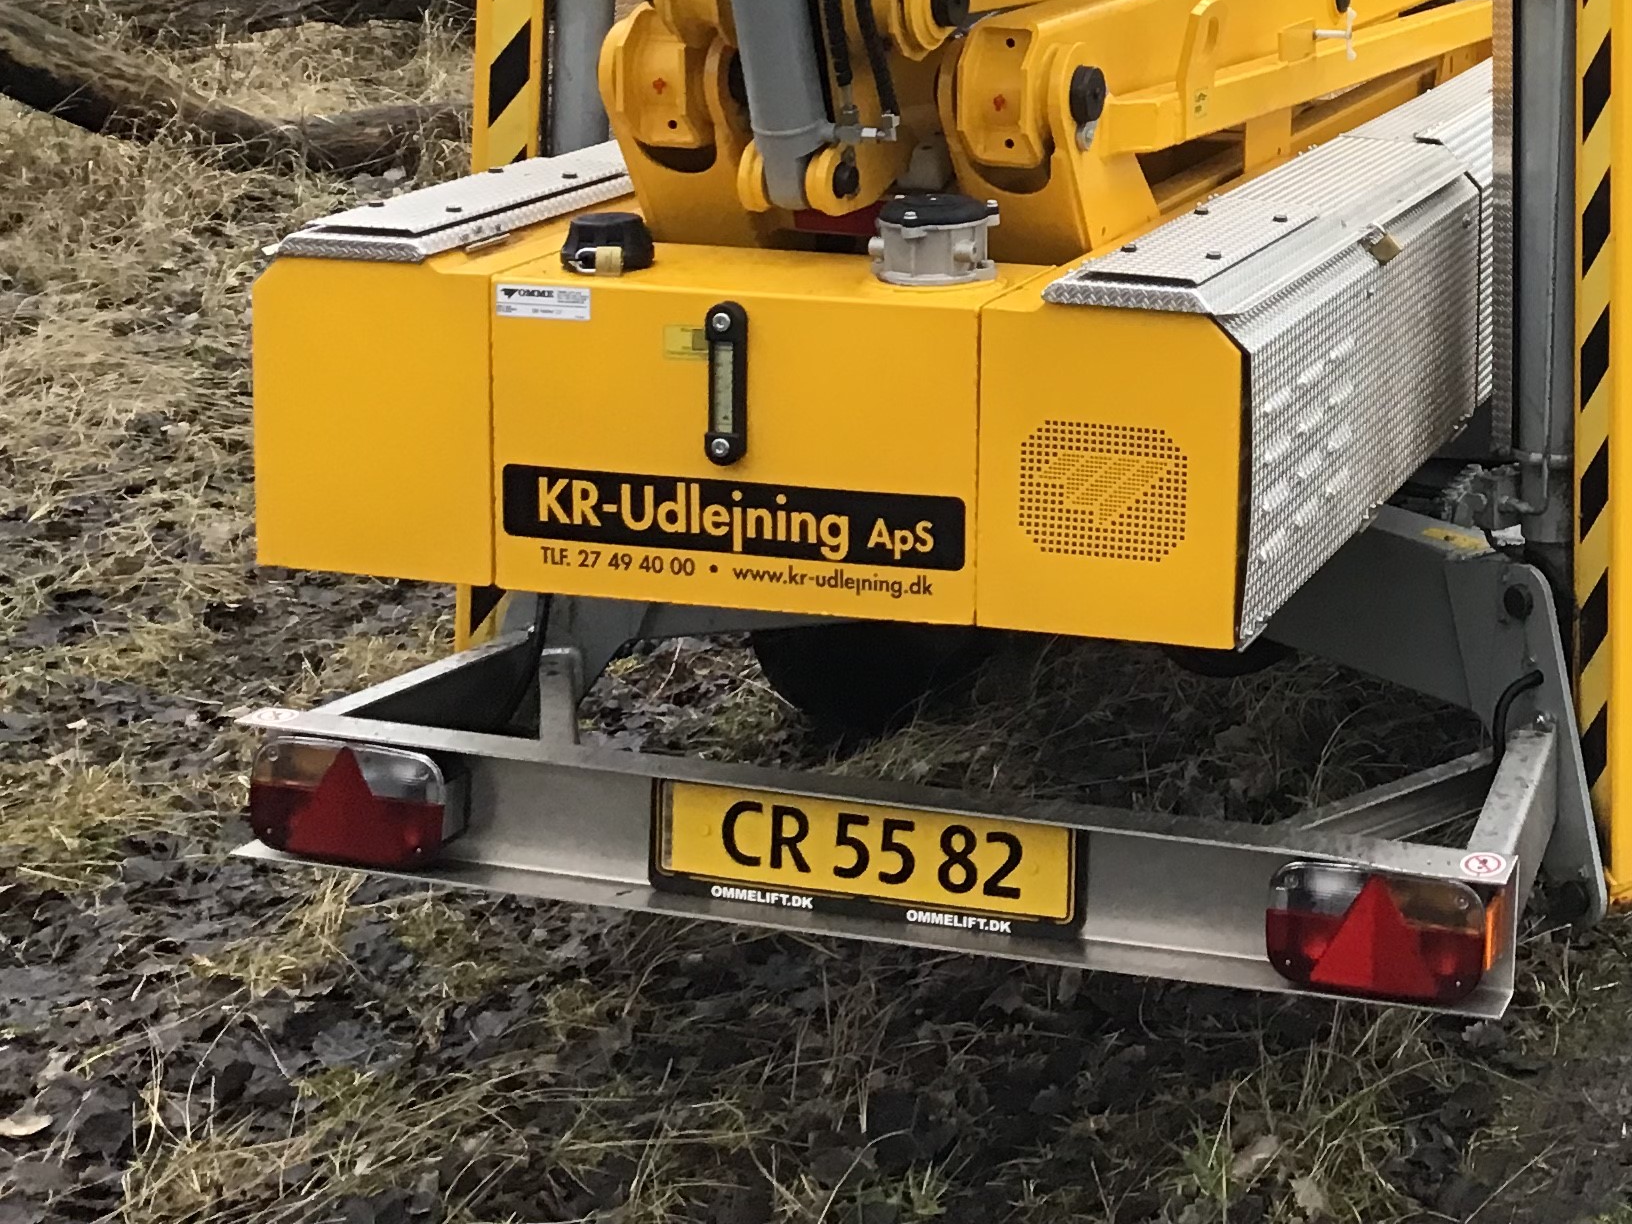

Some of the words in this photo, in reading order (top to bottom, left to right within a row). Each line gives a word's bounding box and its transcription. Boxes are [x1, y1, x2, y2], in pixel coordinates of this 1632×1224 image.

[538, 476, 849, 561] KR-Udlejning
[867, 518, 934, 559] ApS
[541, 546, 571, 567] TLF.
[577, 550, 601, 569] 27
[608, 552, 631, 572] 49
[639, 555, 664, 574] 40
[670, 557, 695, 577] 00
[733, 564, 933, 599] www.kr-udlejning.dk
[721, 800, 811, 873] CR
[832, 812, 915, 885] 55
[937, 824, 1023, 900] 82
[711, 885, 813, 910] OMMELIFT.DK
[906, 909, 1012, 935] OMMELIFT.DK
